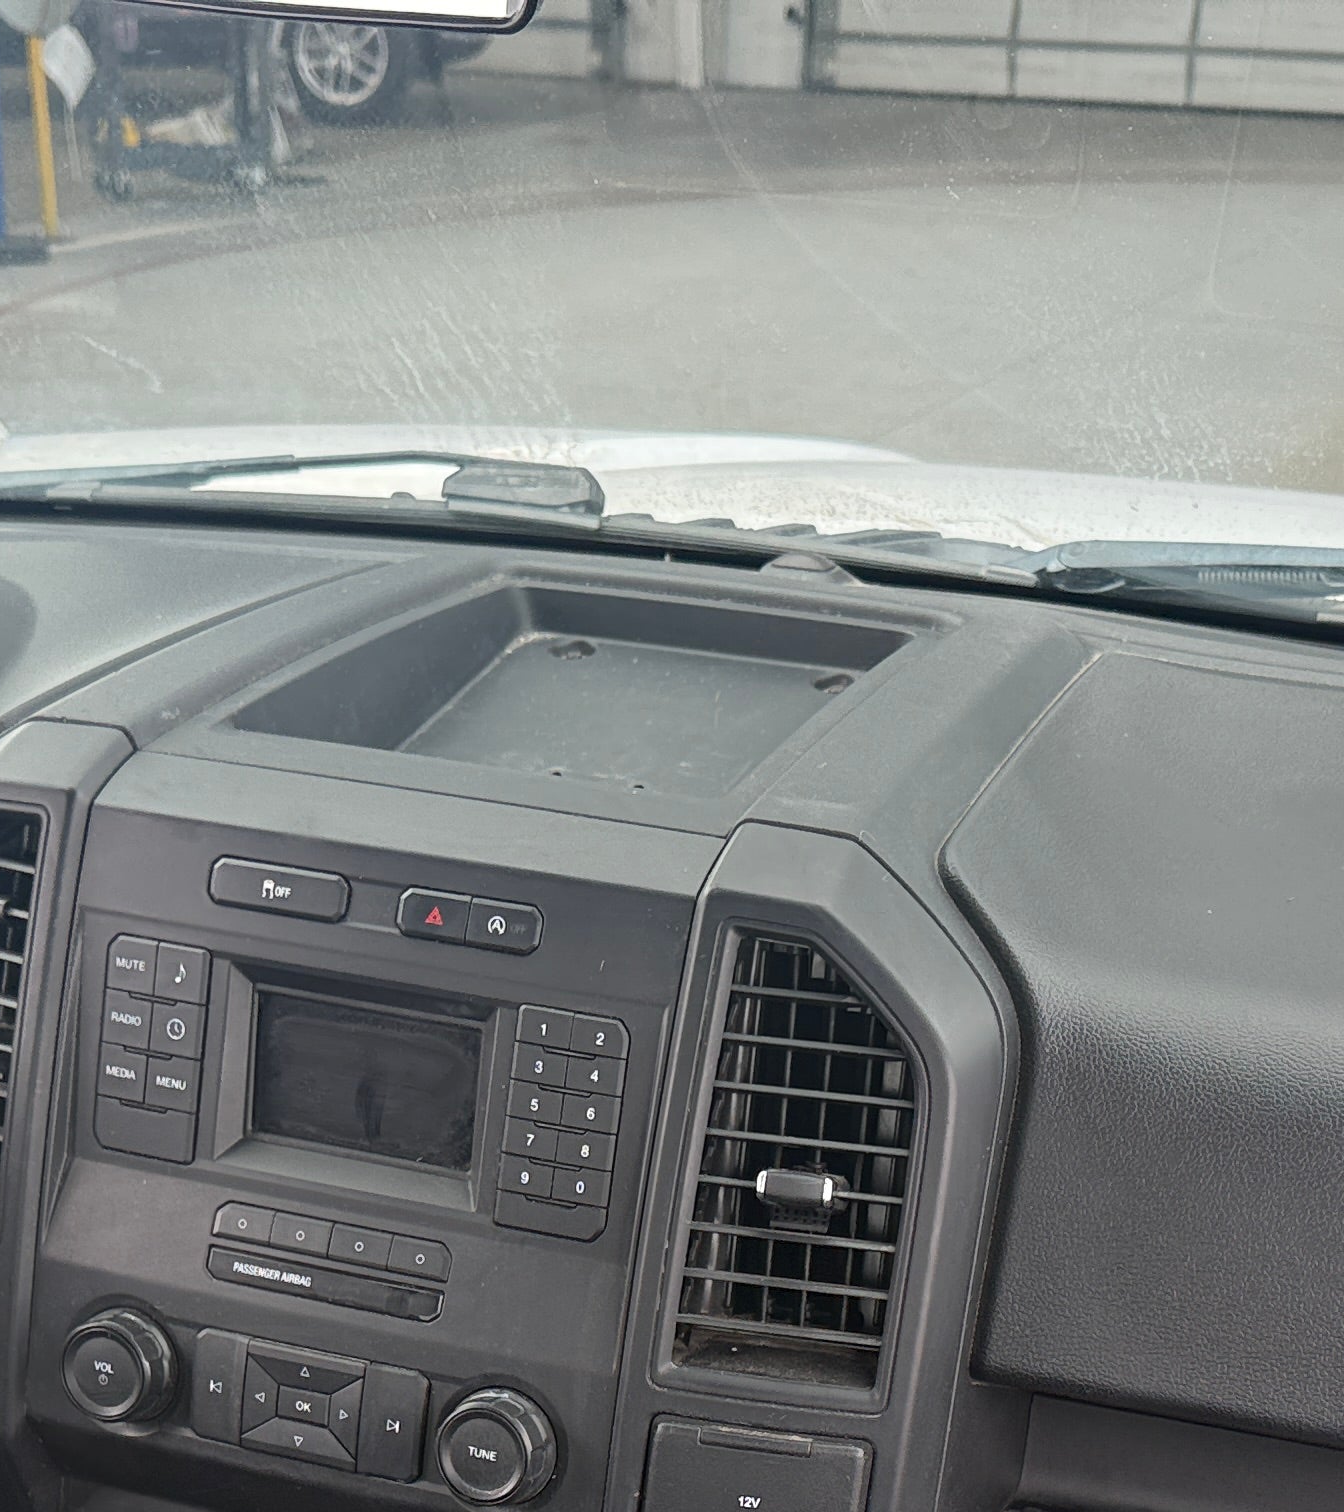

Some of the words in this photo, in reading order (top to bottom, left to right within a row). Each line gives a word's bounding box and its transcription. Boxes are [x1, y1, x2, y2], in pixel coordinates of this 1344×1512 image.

[274, 885, 292, 899] OFF
[115, 956, 146, 972] MUTE
[110, 1011, 142, 1027] RADIO
[540, 1023, 548, 1036] 1
[595, 1032, 605, 1046] 2
[105, 1064, 137, 1081] MEDIA
[534, 1060, 544, 1074] 3
[155, 1075, 187, 1091] MENU
[590, 1069, 599, 1083] 4
[529, 1098, 539, 1112] 5
[586, 1107, 596, 1121] 6
[526, 1133, 535, 1147] 7
[580, 1144, 590, 1158] 8
[520, 1171, 530, 1184] 9
[575, 1180, 585, 1194] 0
[232, 1261, 281, 1281] PASSENGER
[281, 1271, 312, 1287] AIRBAG
[94, 1360, 115, 1375] VOL
[295, 1400, 312, 1413] OK
[467, 1445, 498, 1462] TUNE
[738, 1495, 761, 1509] 12V
